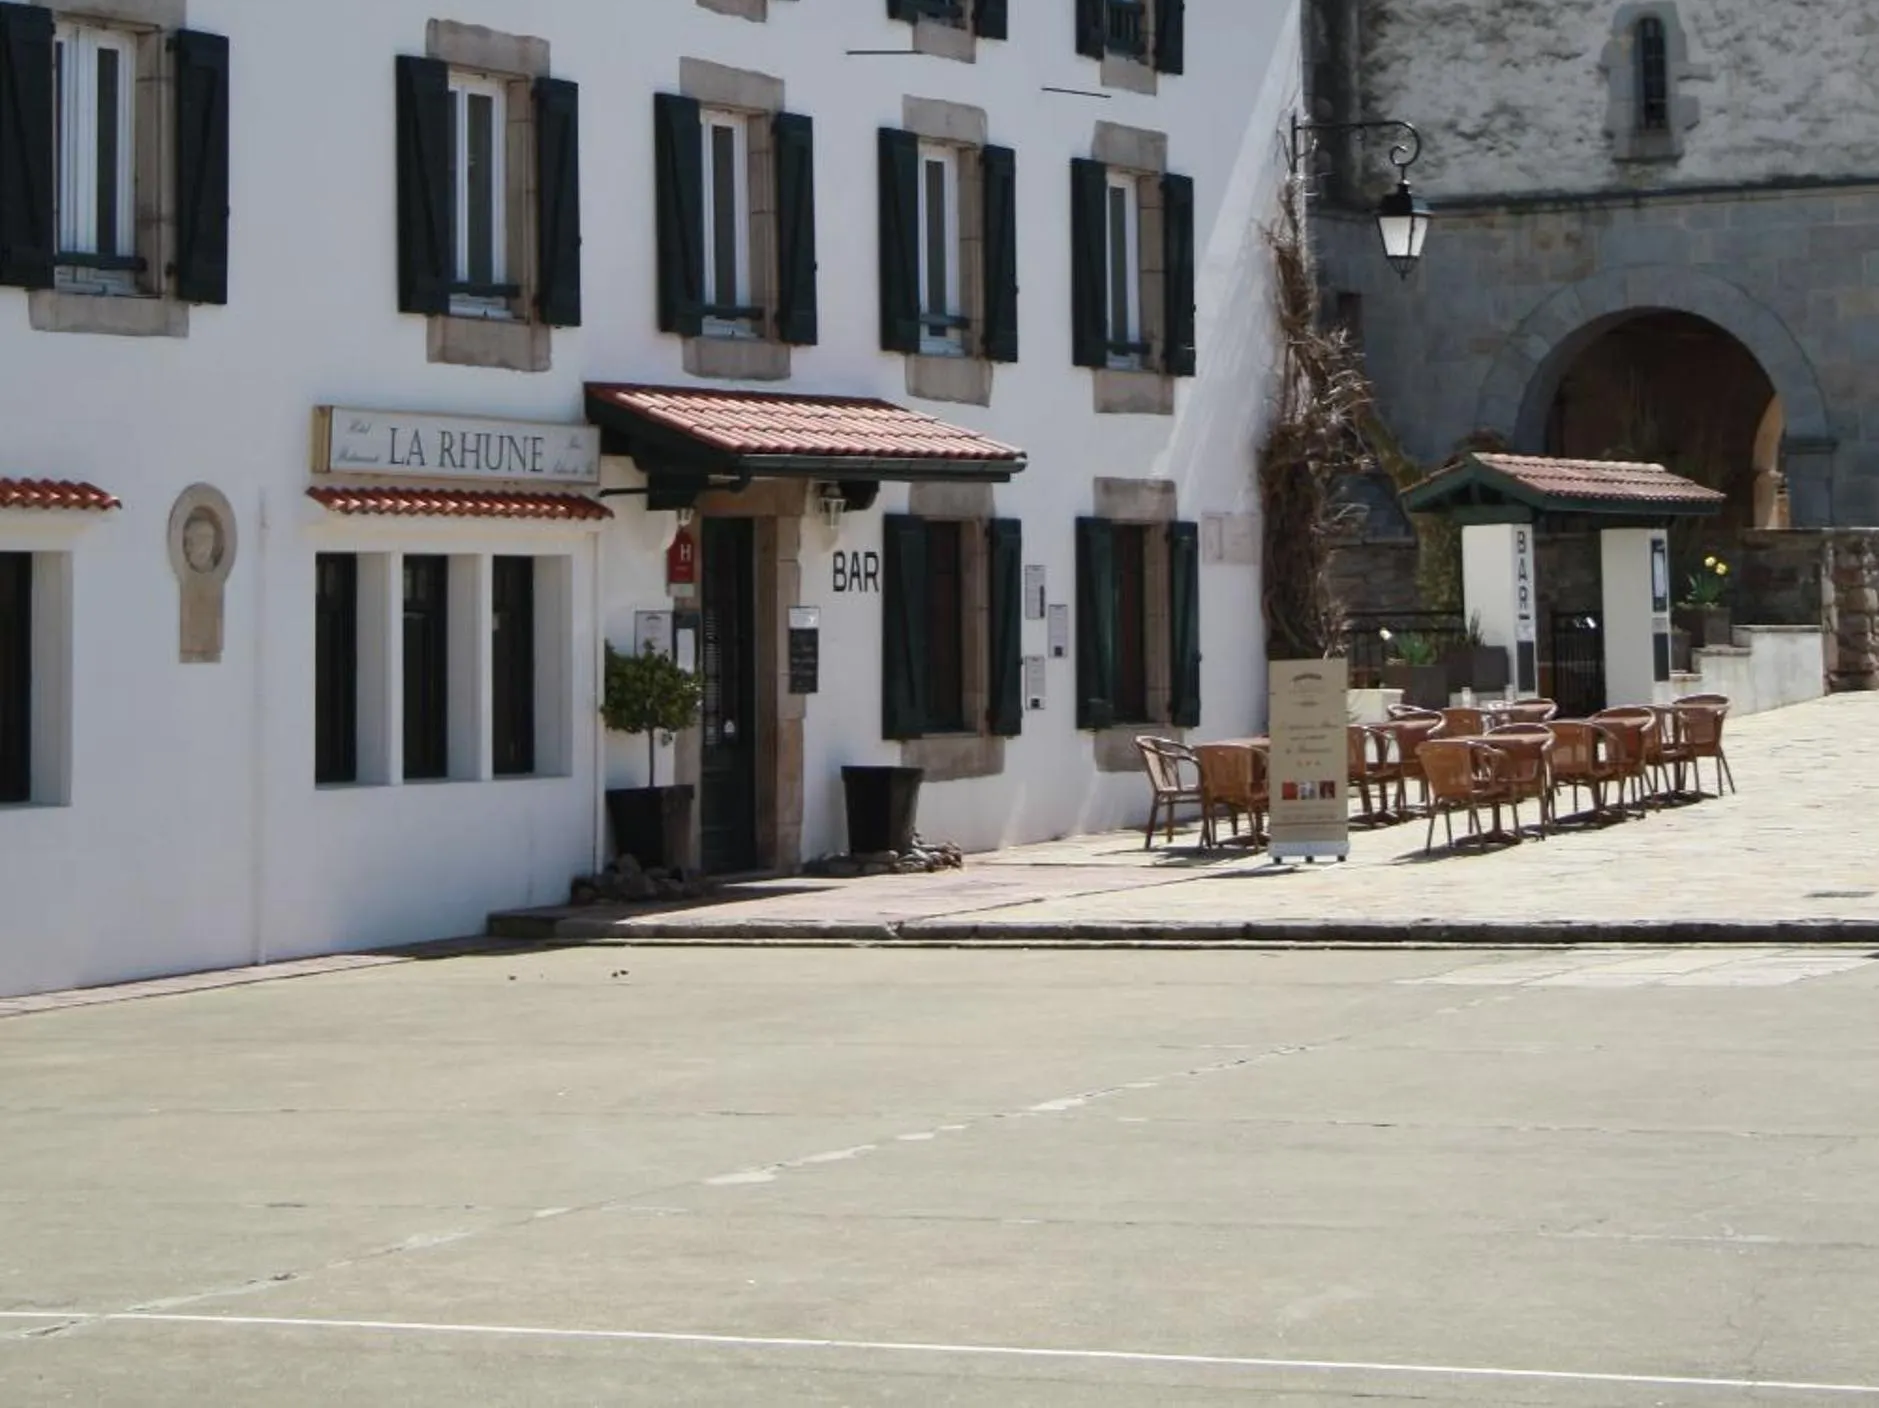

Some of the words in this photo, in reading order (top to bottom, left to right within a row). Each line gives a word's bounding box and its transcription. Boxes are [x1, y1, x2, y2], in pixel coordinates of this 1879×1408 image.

[389, 427, 426, 466] LA
[438, 430, 544, 472] RHUNE
[680, 543, 691, 561] H
[833, 550, 880, 592] BAR
[1517, 531, 1528, 610] BAR
